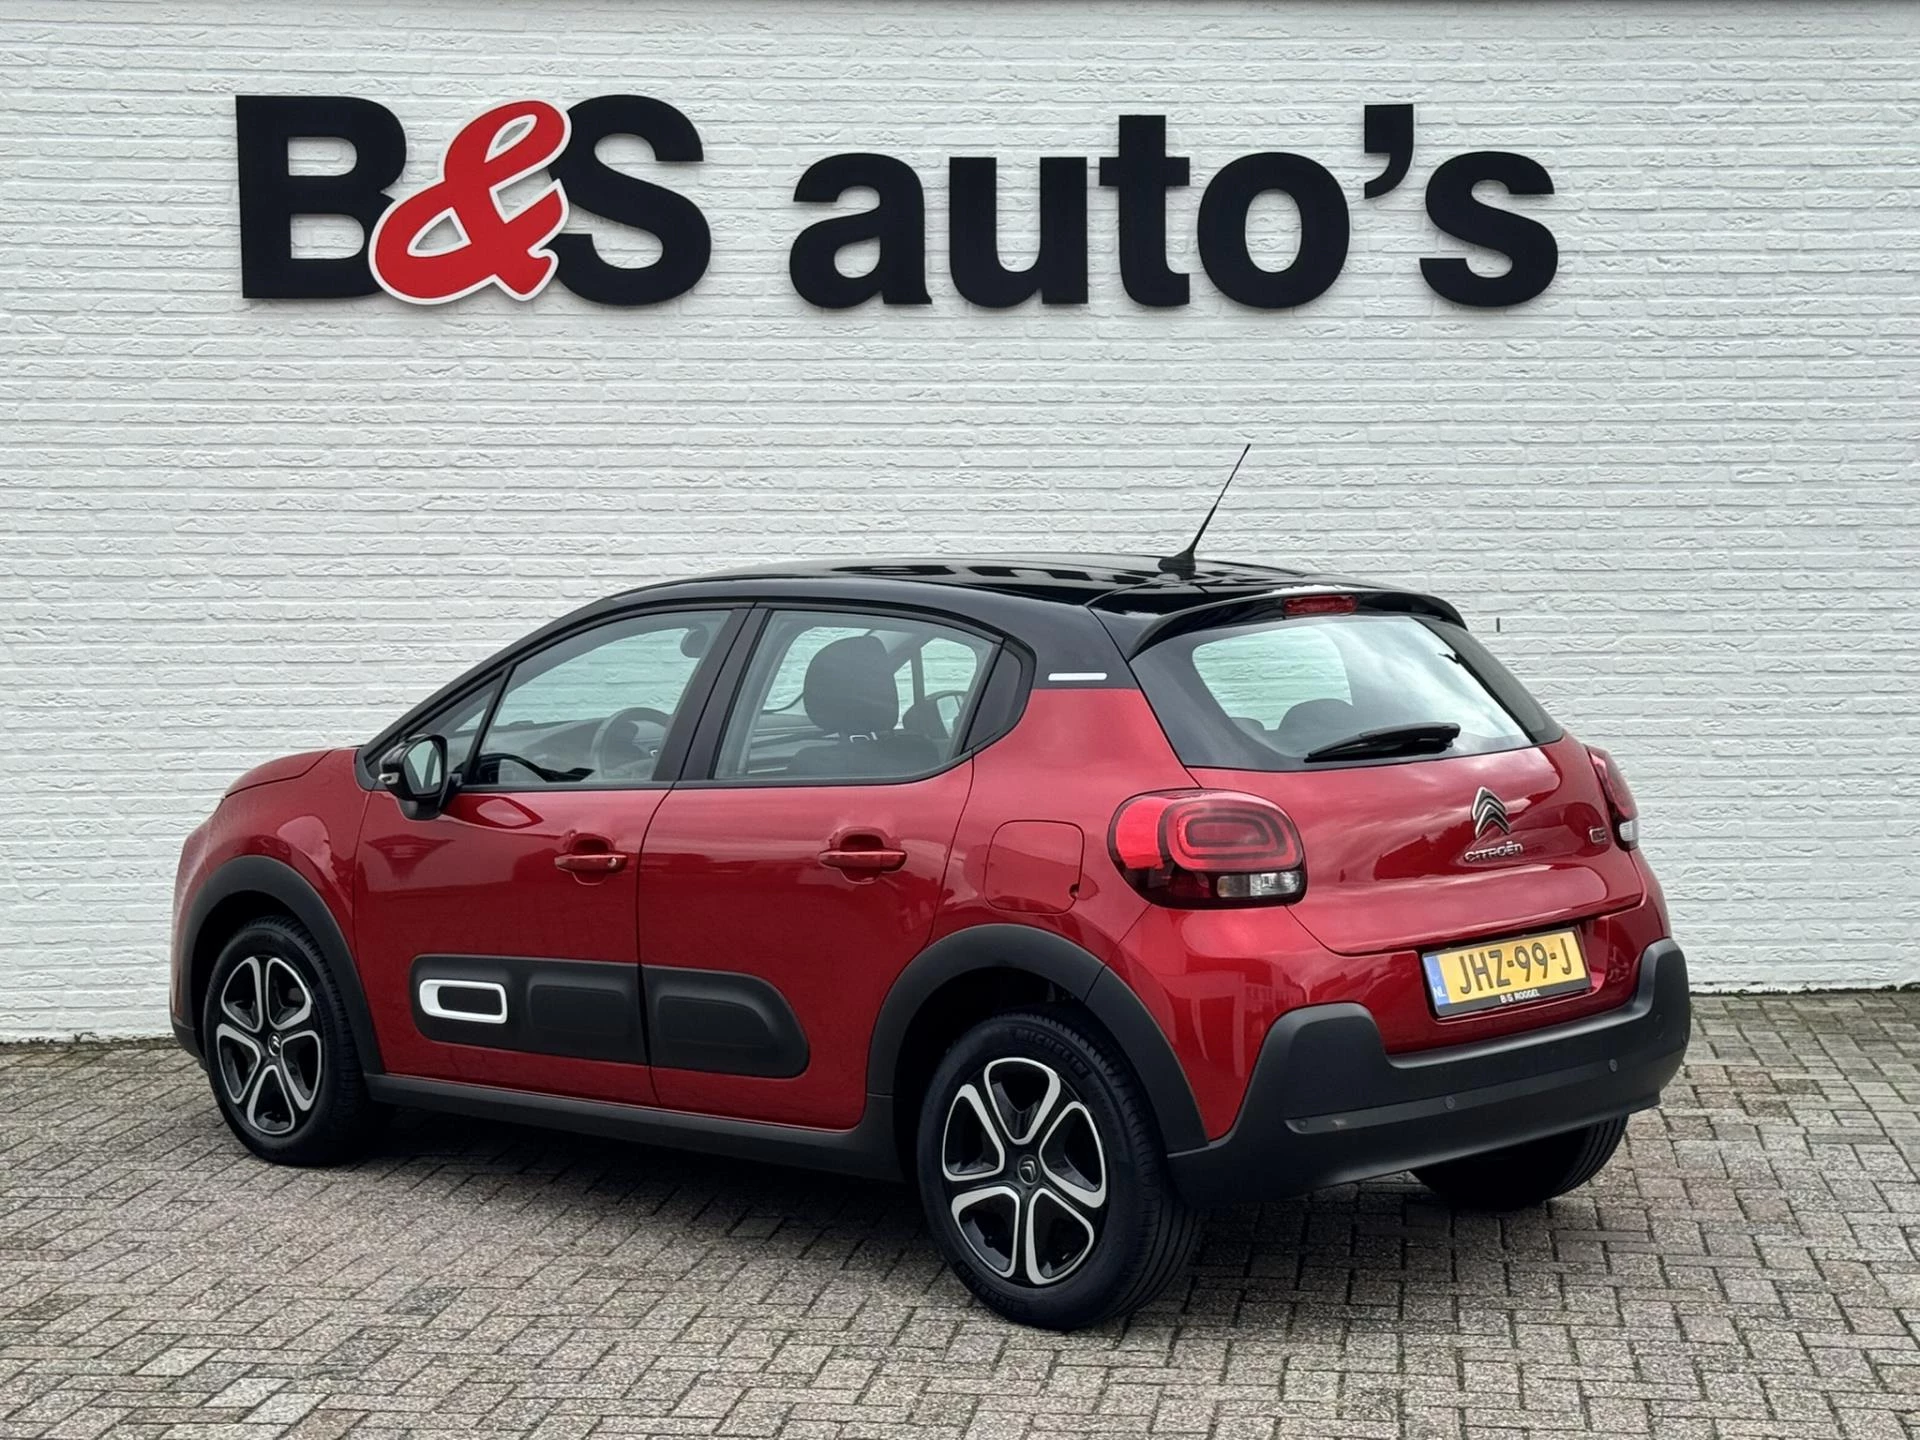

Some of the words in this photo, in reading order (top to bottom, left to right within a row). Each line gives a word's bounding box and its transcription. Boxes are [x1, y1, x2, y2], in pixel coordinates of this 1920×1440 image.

[235, 94, 711, 306] B&S
[789, 103, 1558, 308] auto's
[1433, 986, 1447, 998] NL
[1459, 938, 1572, 994] JHZ-99-J
